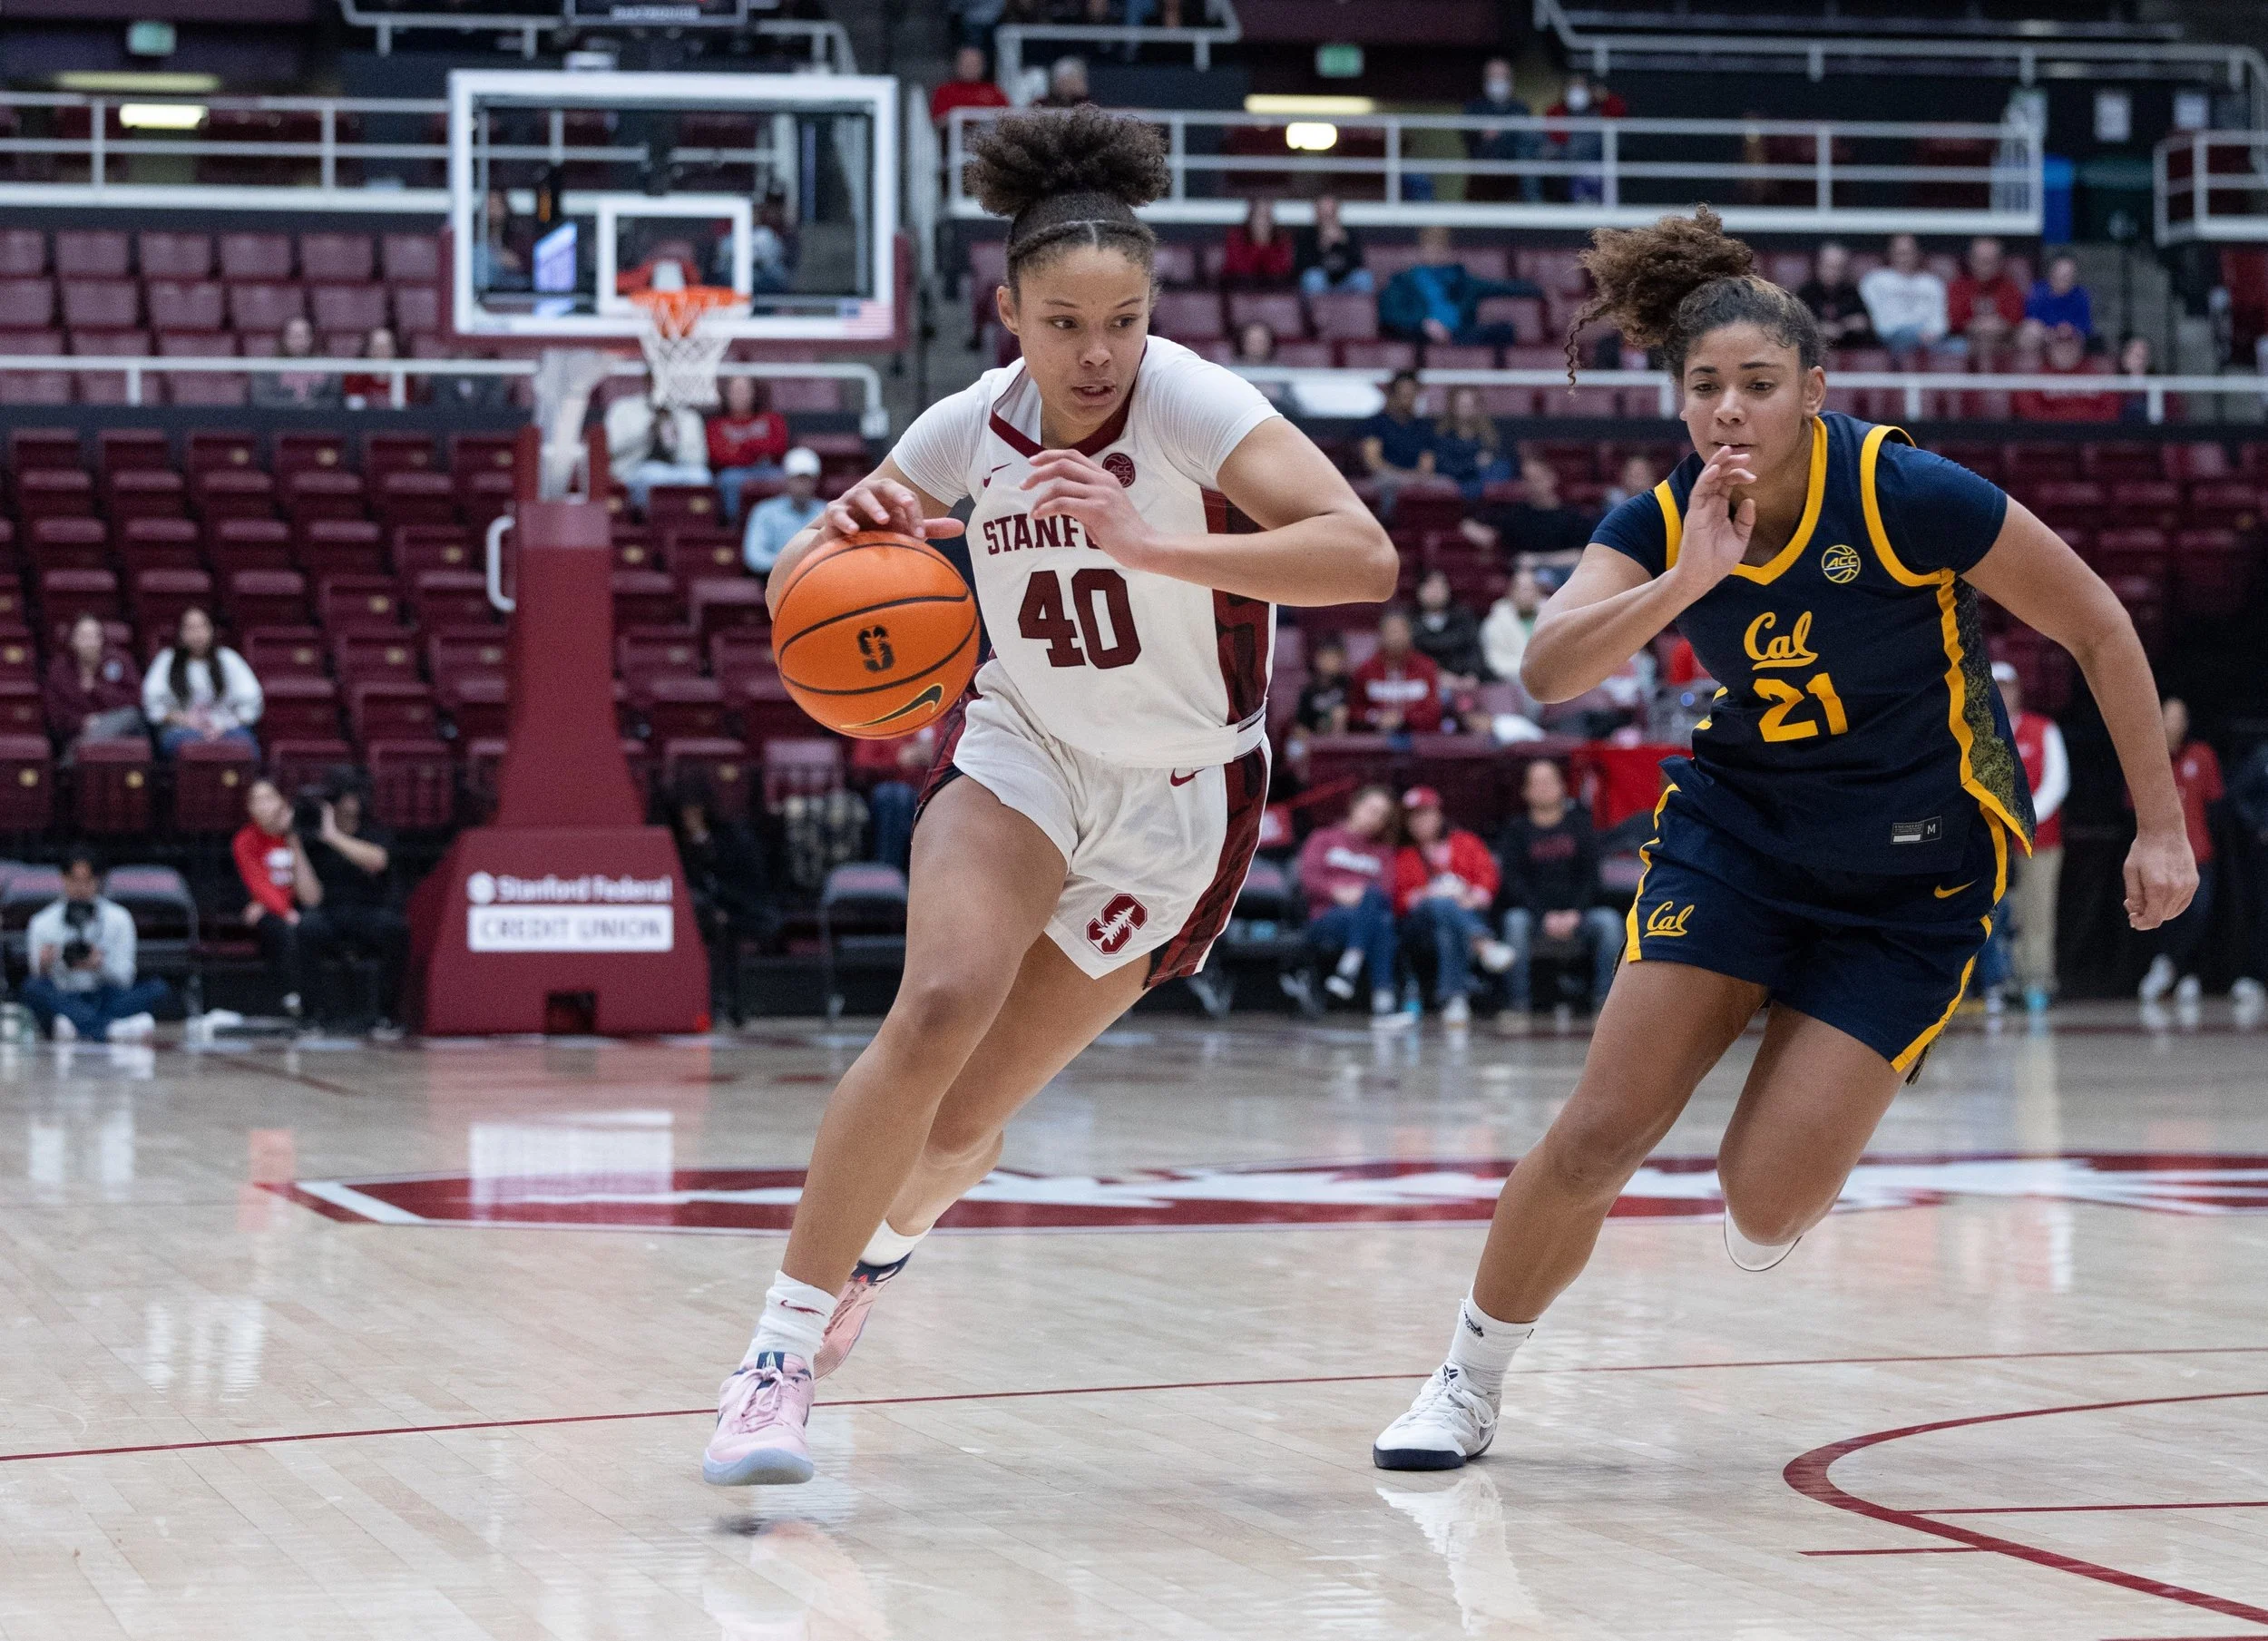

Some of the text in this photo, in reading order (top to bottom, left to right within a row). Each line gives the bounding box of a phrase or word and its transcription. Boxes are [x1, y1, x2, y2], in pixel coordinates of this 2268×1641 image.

[982, 513, 1102, 556] STANF
[1825, 554, 1859, 568] ACC
[1017, 568, 1142, 669] 40
[1743, 610, 1819, 670] Cal
[1753, 672, 1849, 743] 21
[1927, 823, 1937, 835] M
[498, 874, 673, 903] Stanford Federal
[480, 917, 662, 939] CREDIT UNION
[1643, 901, 1695, 938] Cal
